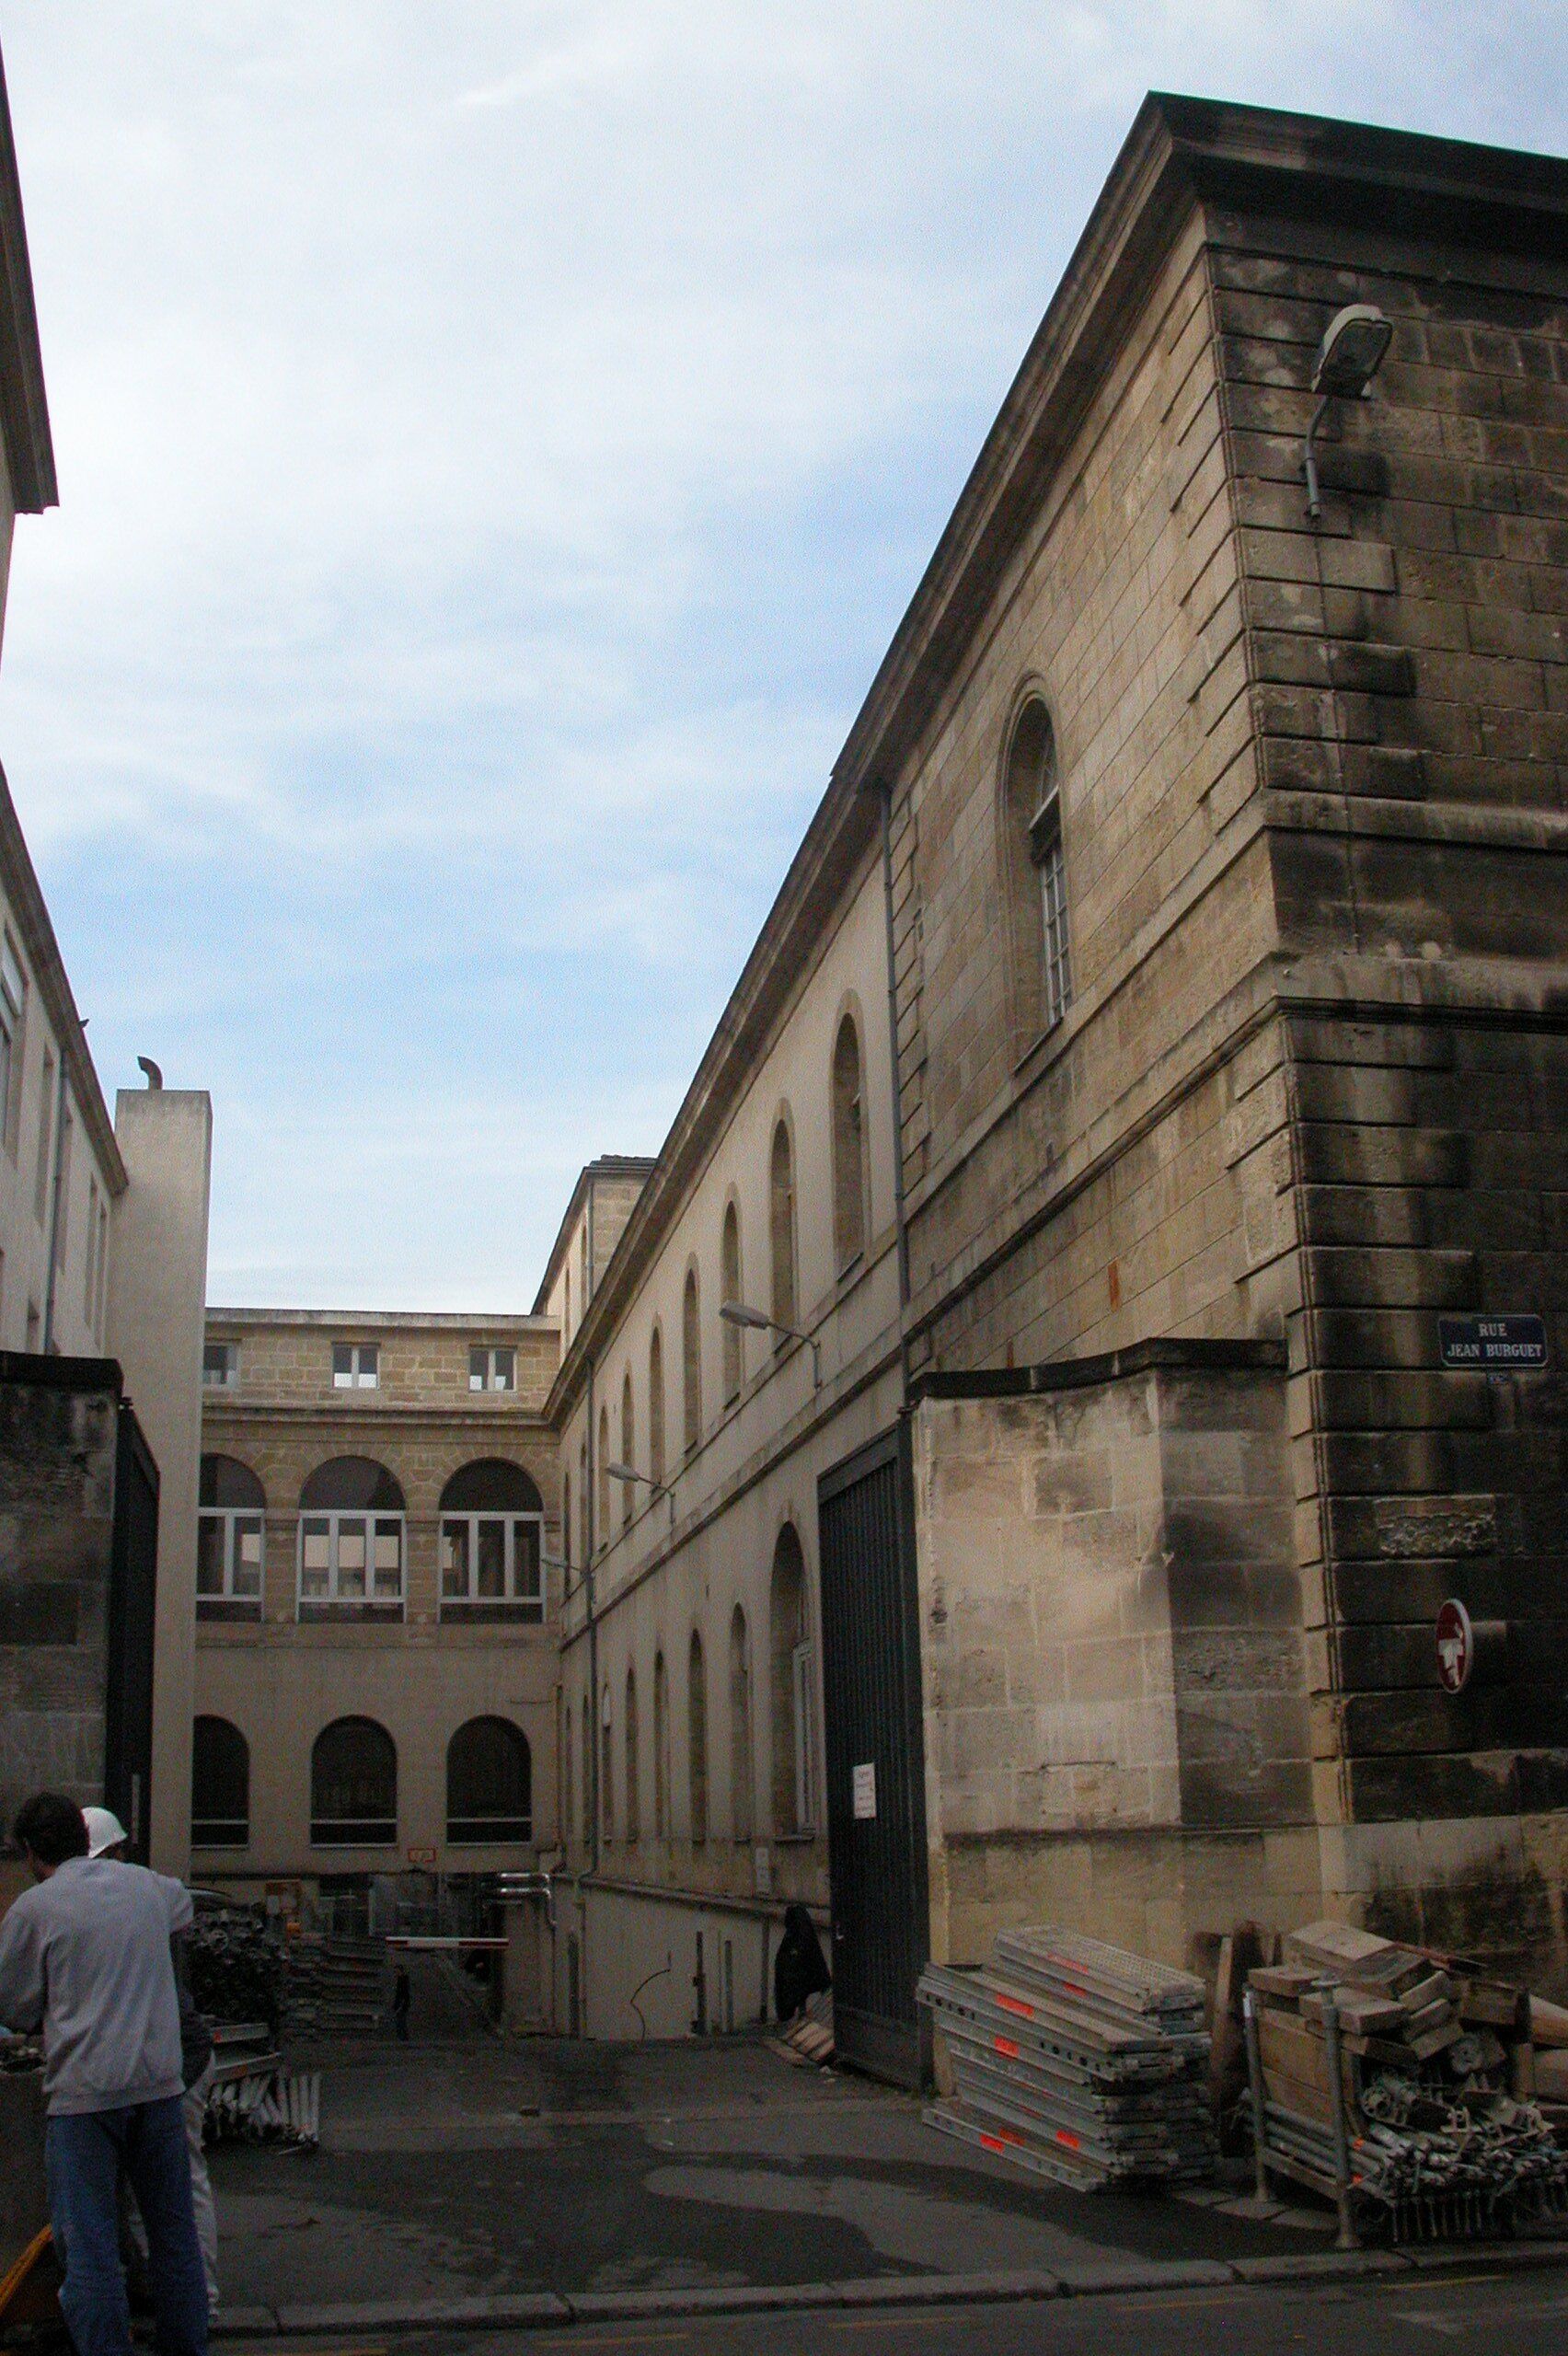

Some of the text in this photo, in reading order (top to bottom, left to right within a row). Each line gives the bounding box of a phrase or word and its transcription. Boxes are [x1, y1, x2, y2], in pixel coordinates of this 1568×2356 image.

[1478, 1322, 1508, 1337] RUE
[1447, 1343, 1542, 1357] JEAN BURGUET
